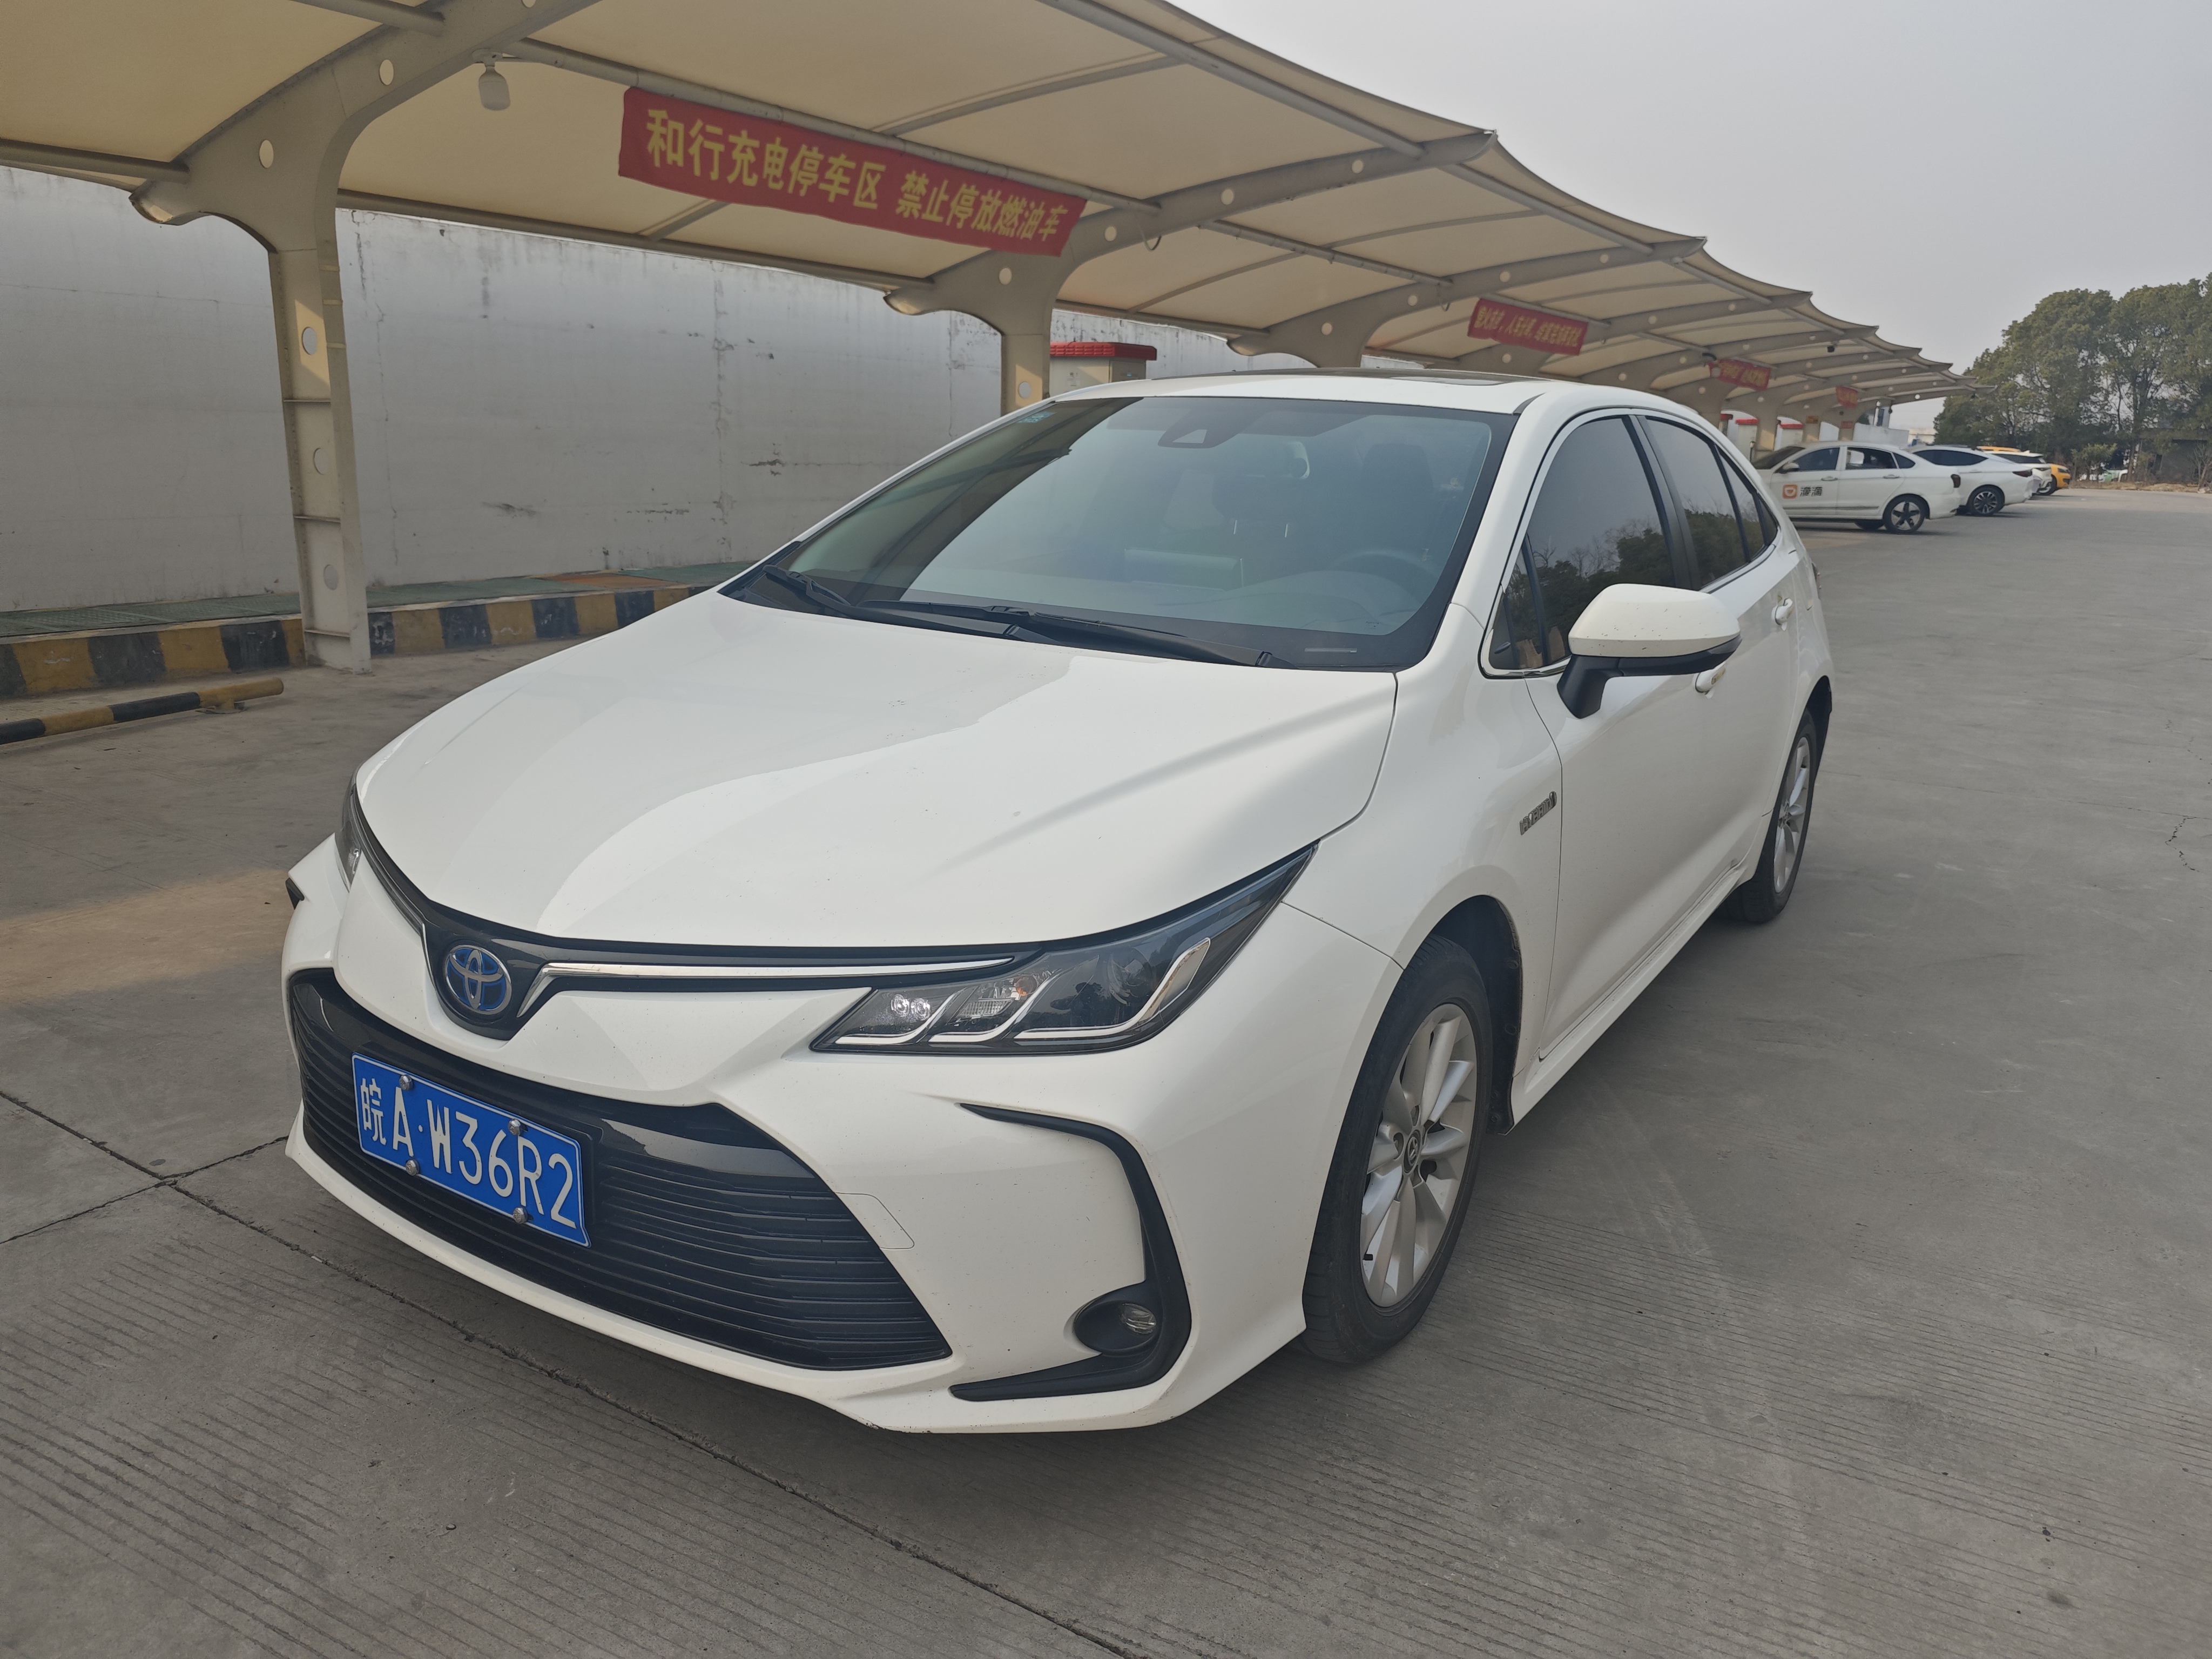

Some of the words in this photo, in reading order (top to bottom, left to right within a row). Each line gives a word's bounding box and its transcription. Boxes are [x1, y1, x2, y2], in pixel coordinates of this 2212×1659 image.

[646, 108, 887, 211] 和行充电停车区
[895, 170, 1069, 242] 禁止停放燃油车
